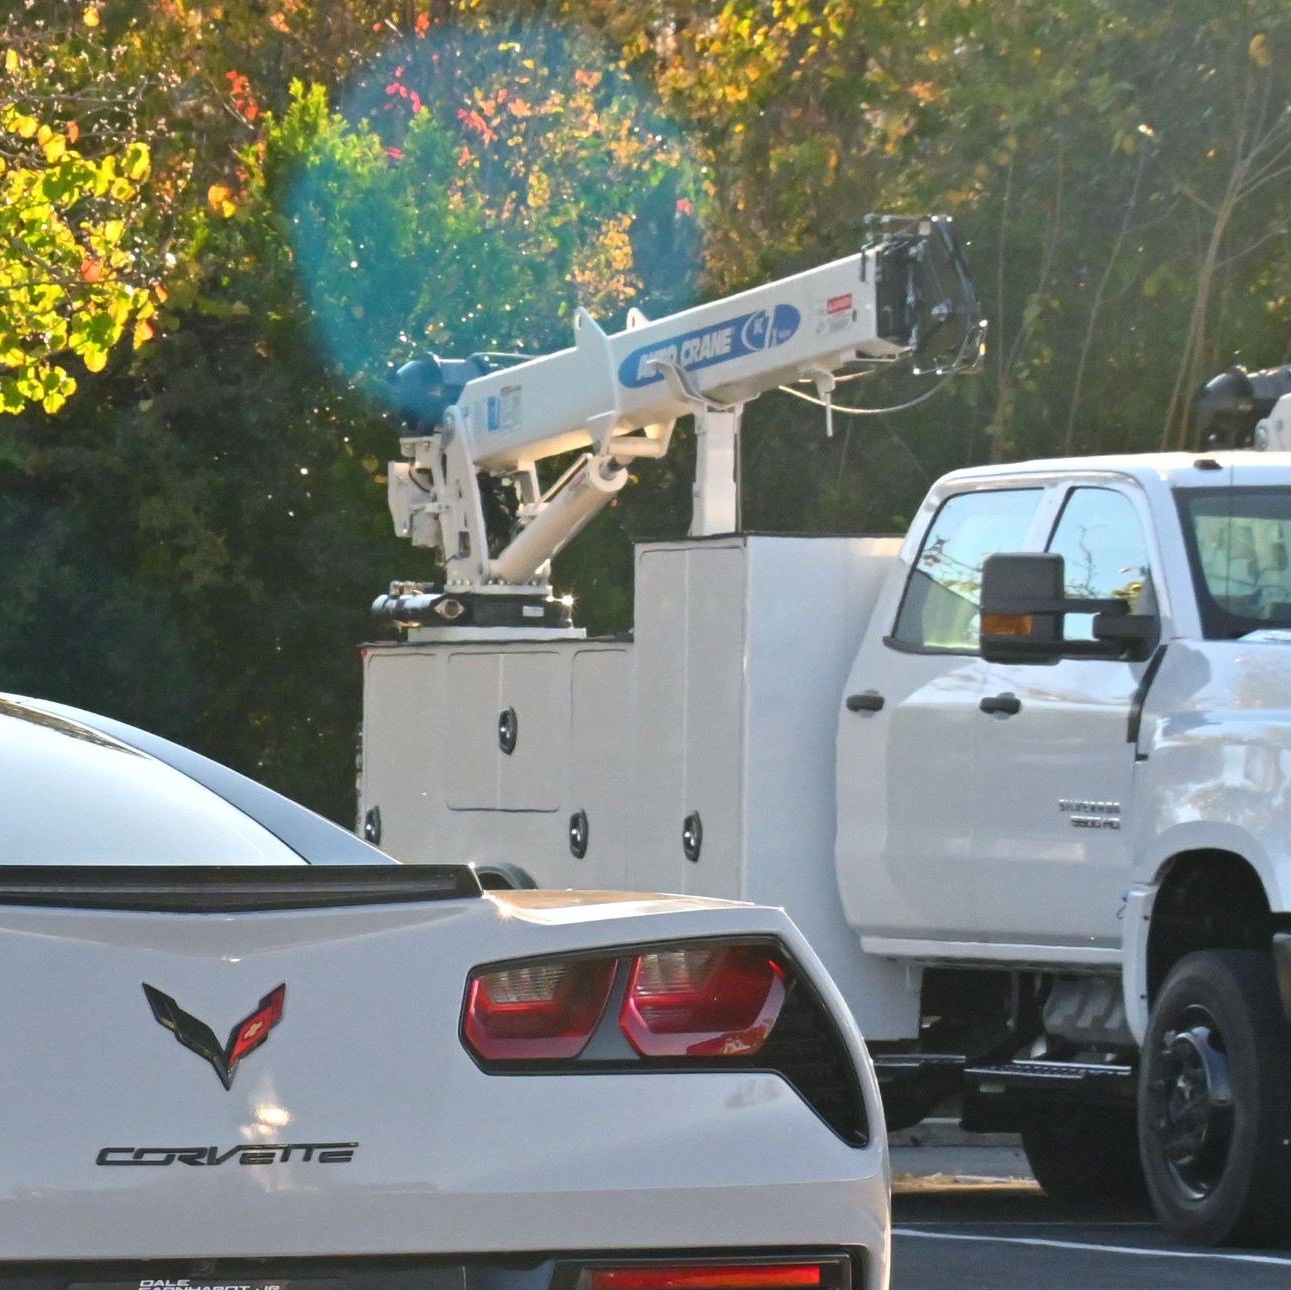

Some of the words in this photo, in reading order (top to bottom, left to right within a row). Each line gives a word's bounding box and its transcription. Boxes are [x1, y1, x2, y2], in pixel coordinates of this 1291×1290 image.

[680, 327, 733, 367] CRANE
[96, 1142, 359, 1166] CORVETTE
[139, 1279, 190, 1287] DALE
